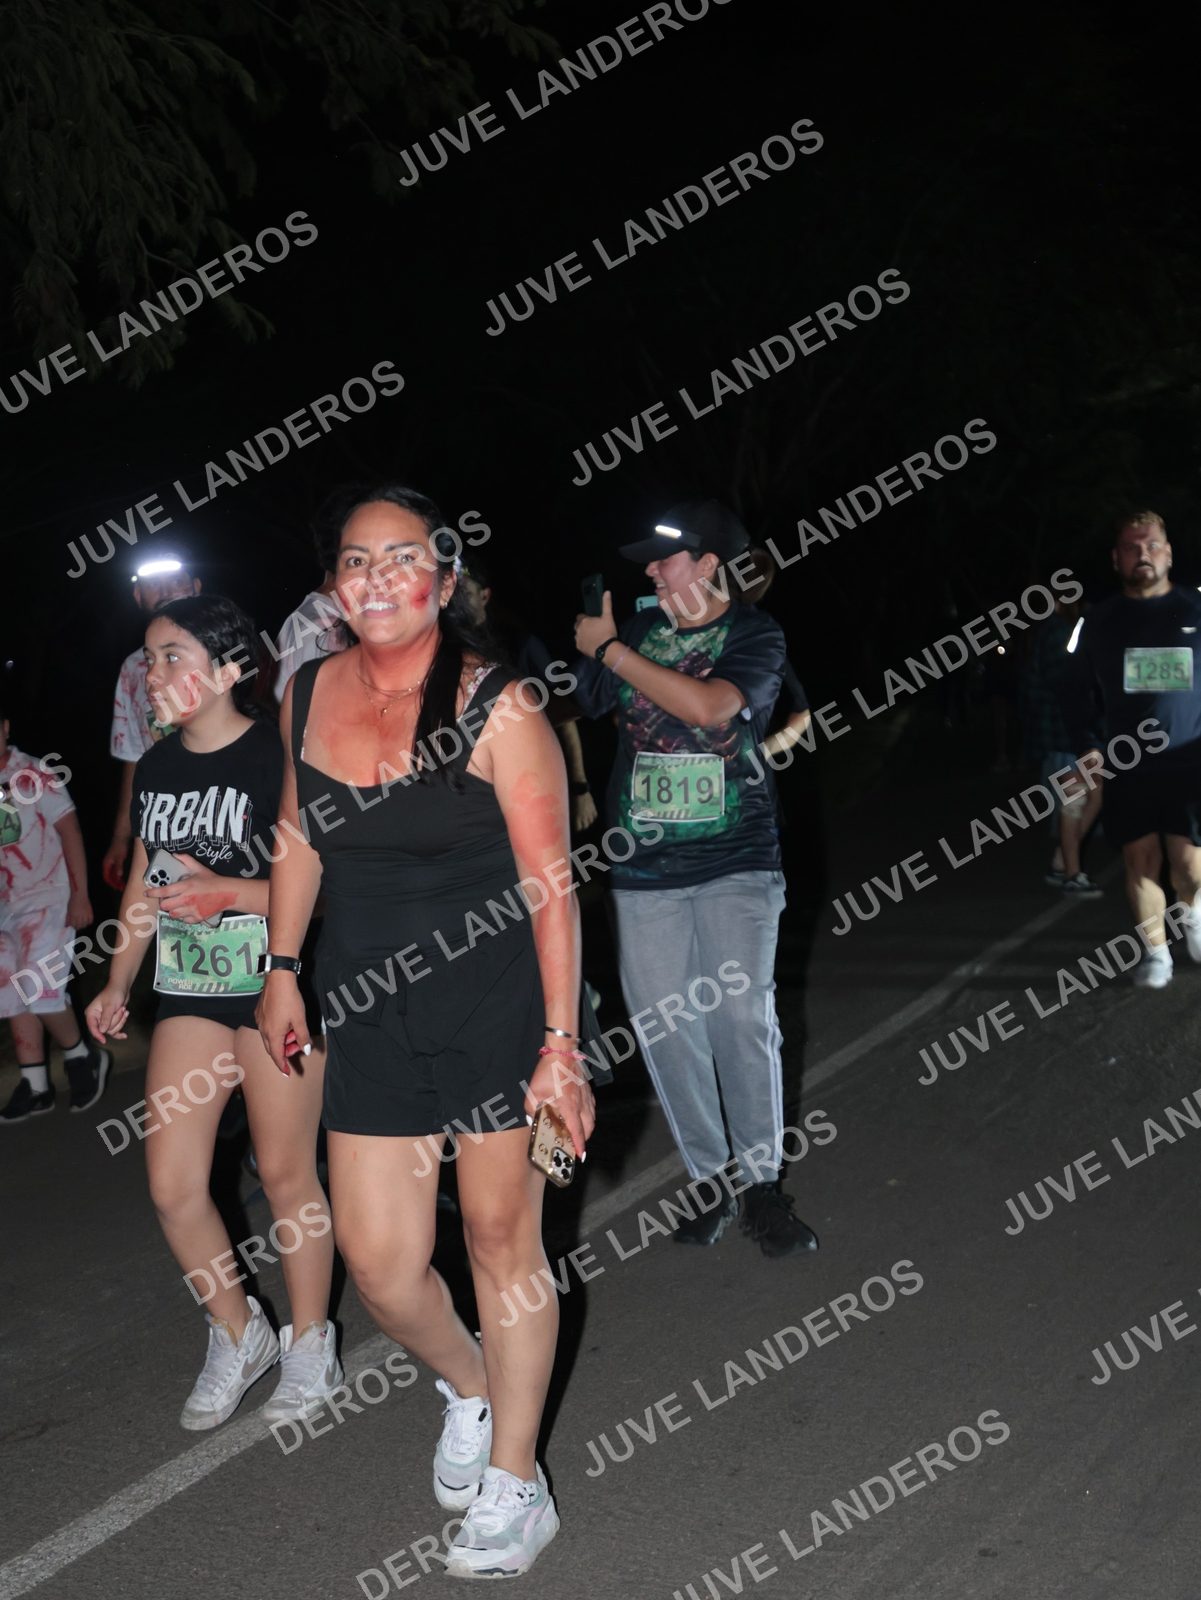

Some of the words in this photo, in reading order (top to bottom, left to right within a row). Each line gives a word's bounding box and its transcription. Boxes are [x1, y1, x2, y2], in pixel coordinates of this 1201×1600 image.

[1132, 661, 1186, 681] 1285
[641, 774, 714, 804] 1819
[195, 841, 234, 865] Style
[170, 939, 253, 977] 1261
